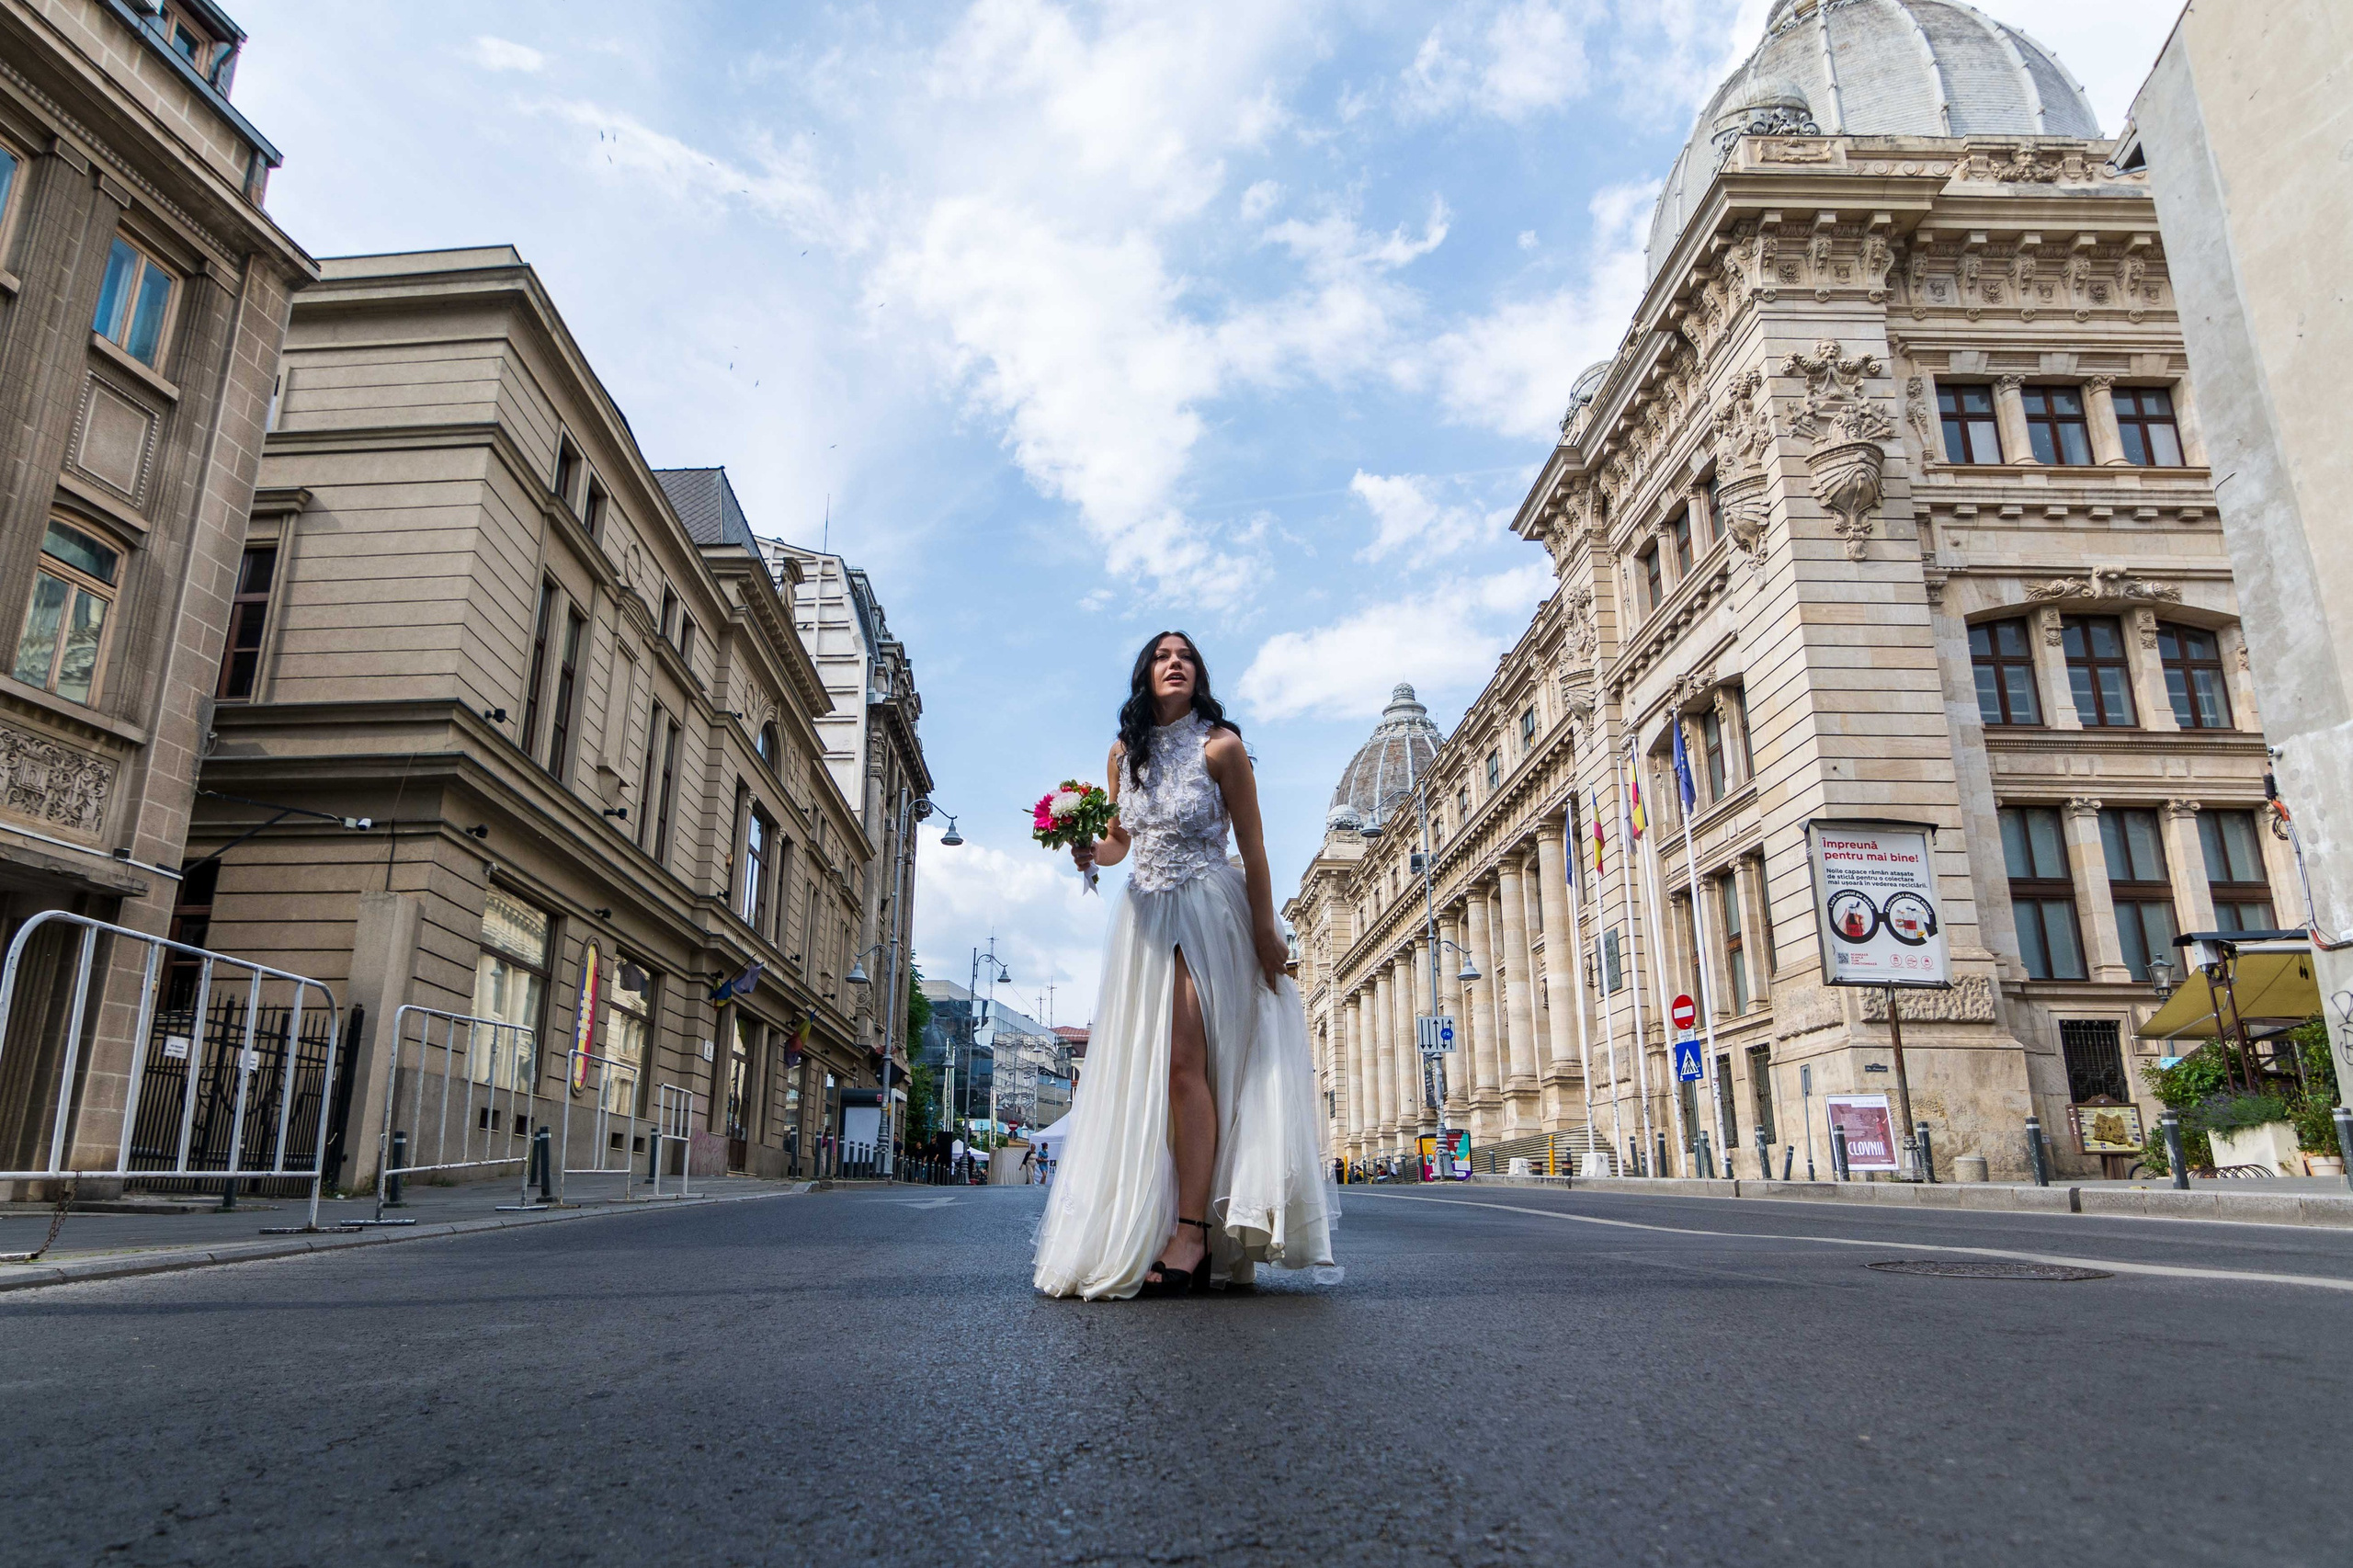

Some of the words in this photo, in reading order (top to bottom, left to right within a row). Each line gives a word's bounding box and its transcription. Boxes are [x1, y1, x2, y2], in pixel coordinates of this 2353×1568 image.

[1822, 837, 1878, 850] Împreună
[1824, 851, 1863, 860] pentru
[1867, 853, 1887, 861] mai
[1891, 853, 1919, 862] bine!
[1847, 1141, 1885, 1156] CLOVNII
